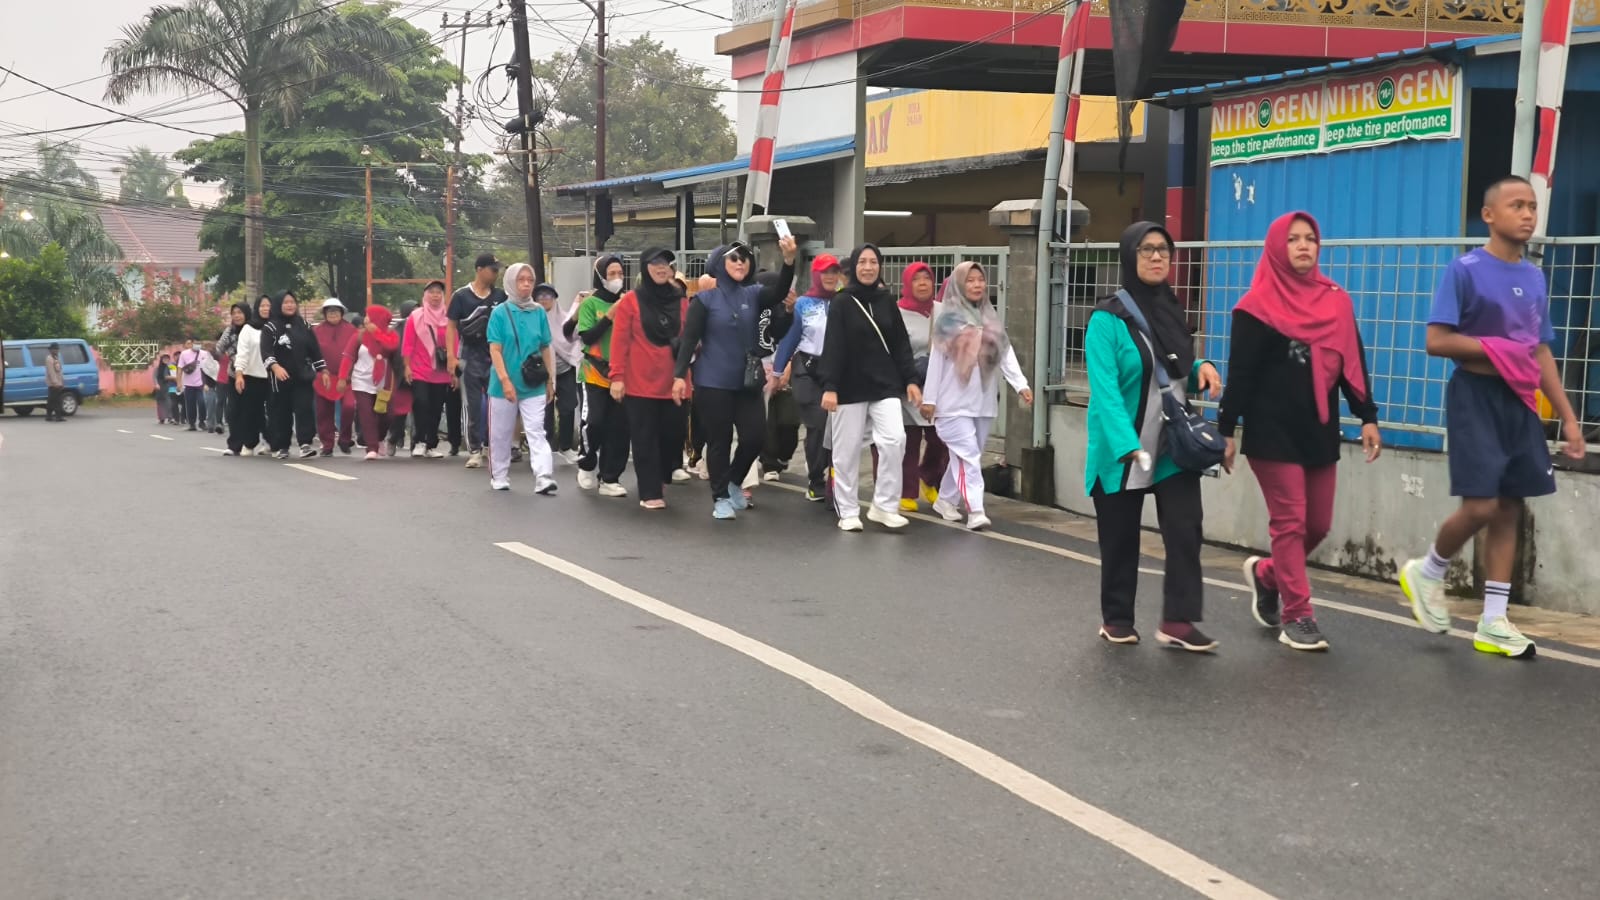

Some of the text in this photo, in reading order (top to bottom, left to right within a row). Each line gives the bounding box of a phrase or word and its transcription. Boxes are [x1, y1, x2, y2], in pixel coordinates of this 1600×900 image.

[1211, 90, 1319, 134] NITROGEN
[1325, 68, 1450, 117] NITROGEN
[866, 102, 894, 154] AH
[1211, 133, 1316, 157] keep the tire perfomance
[1346, 123, 1363, 139] the
[1364, 121, 1382, 136] tire
[1384, 114, 1448, 137] perfomance
